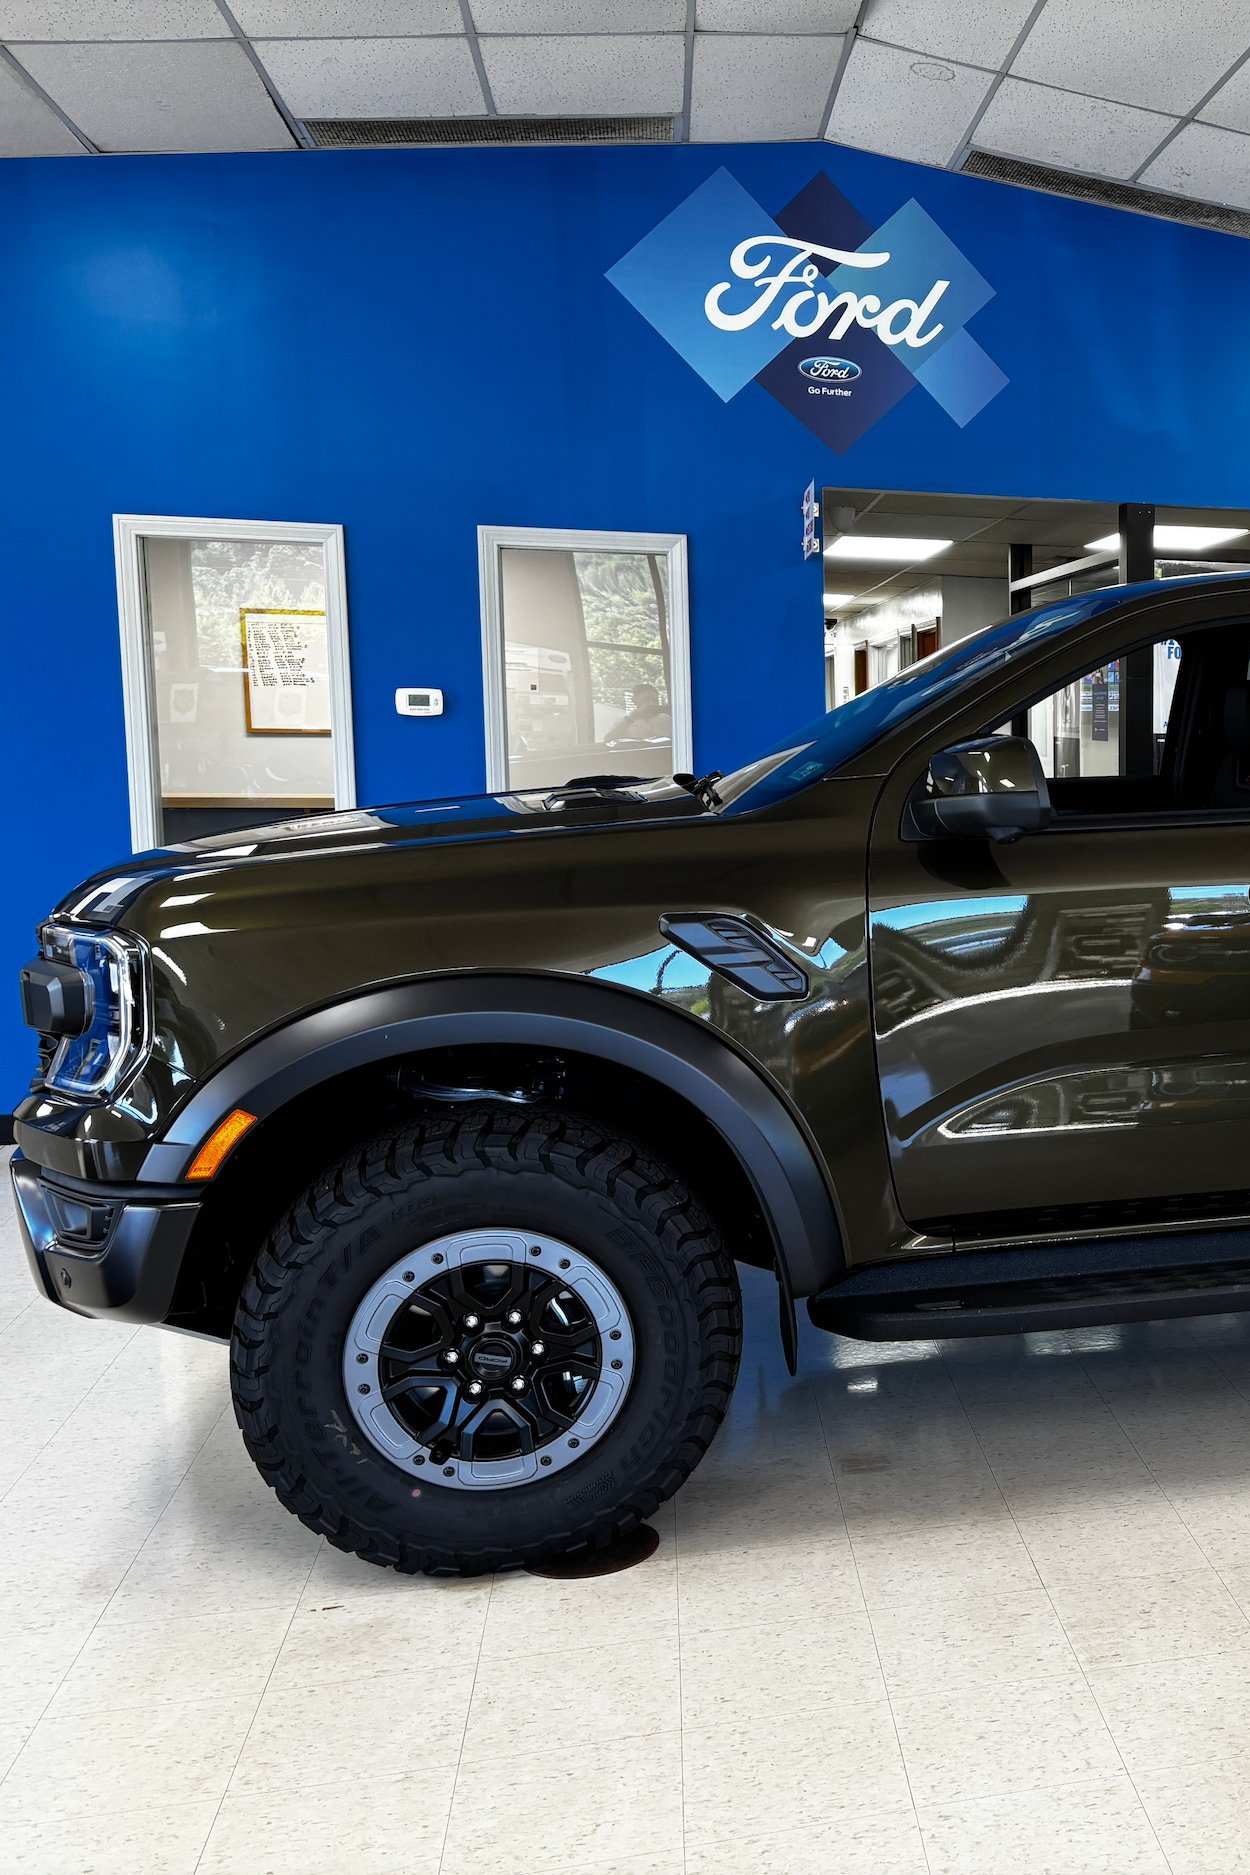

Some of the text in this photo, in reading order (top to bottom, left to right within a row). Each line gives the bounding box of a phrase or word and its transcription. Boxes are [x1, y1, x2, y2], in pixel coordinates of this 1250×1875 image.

[704, 235, 951, 348] Ford
[810, 360, 850, 378] Ford
[808, 386, 852, 397] Go Further
[1167, 647, 1182, 659] FO
